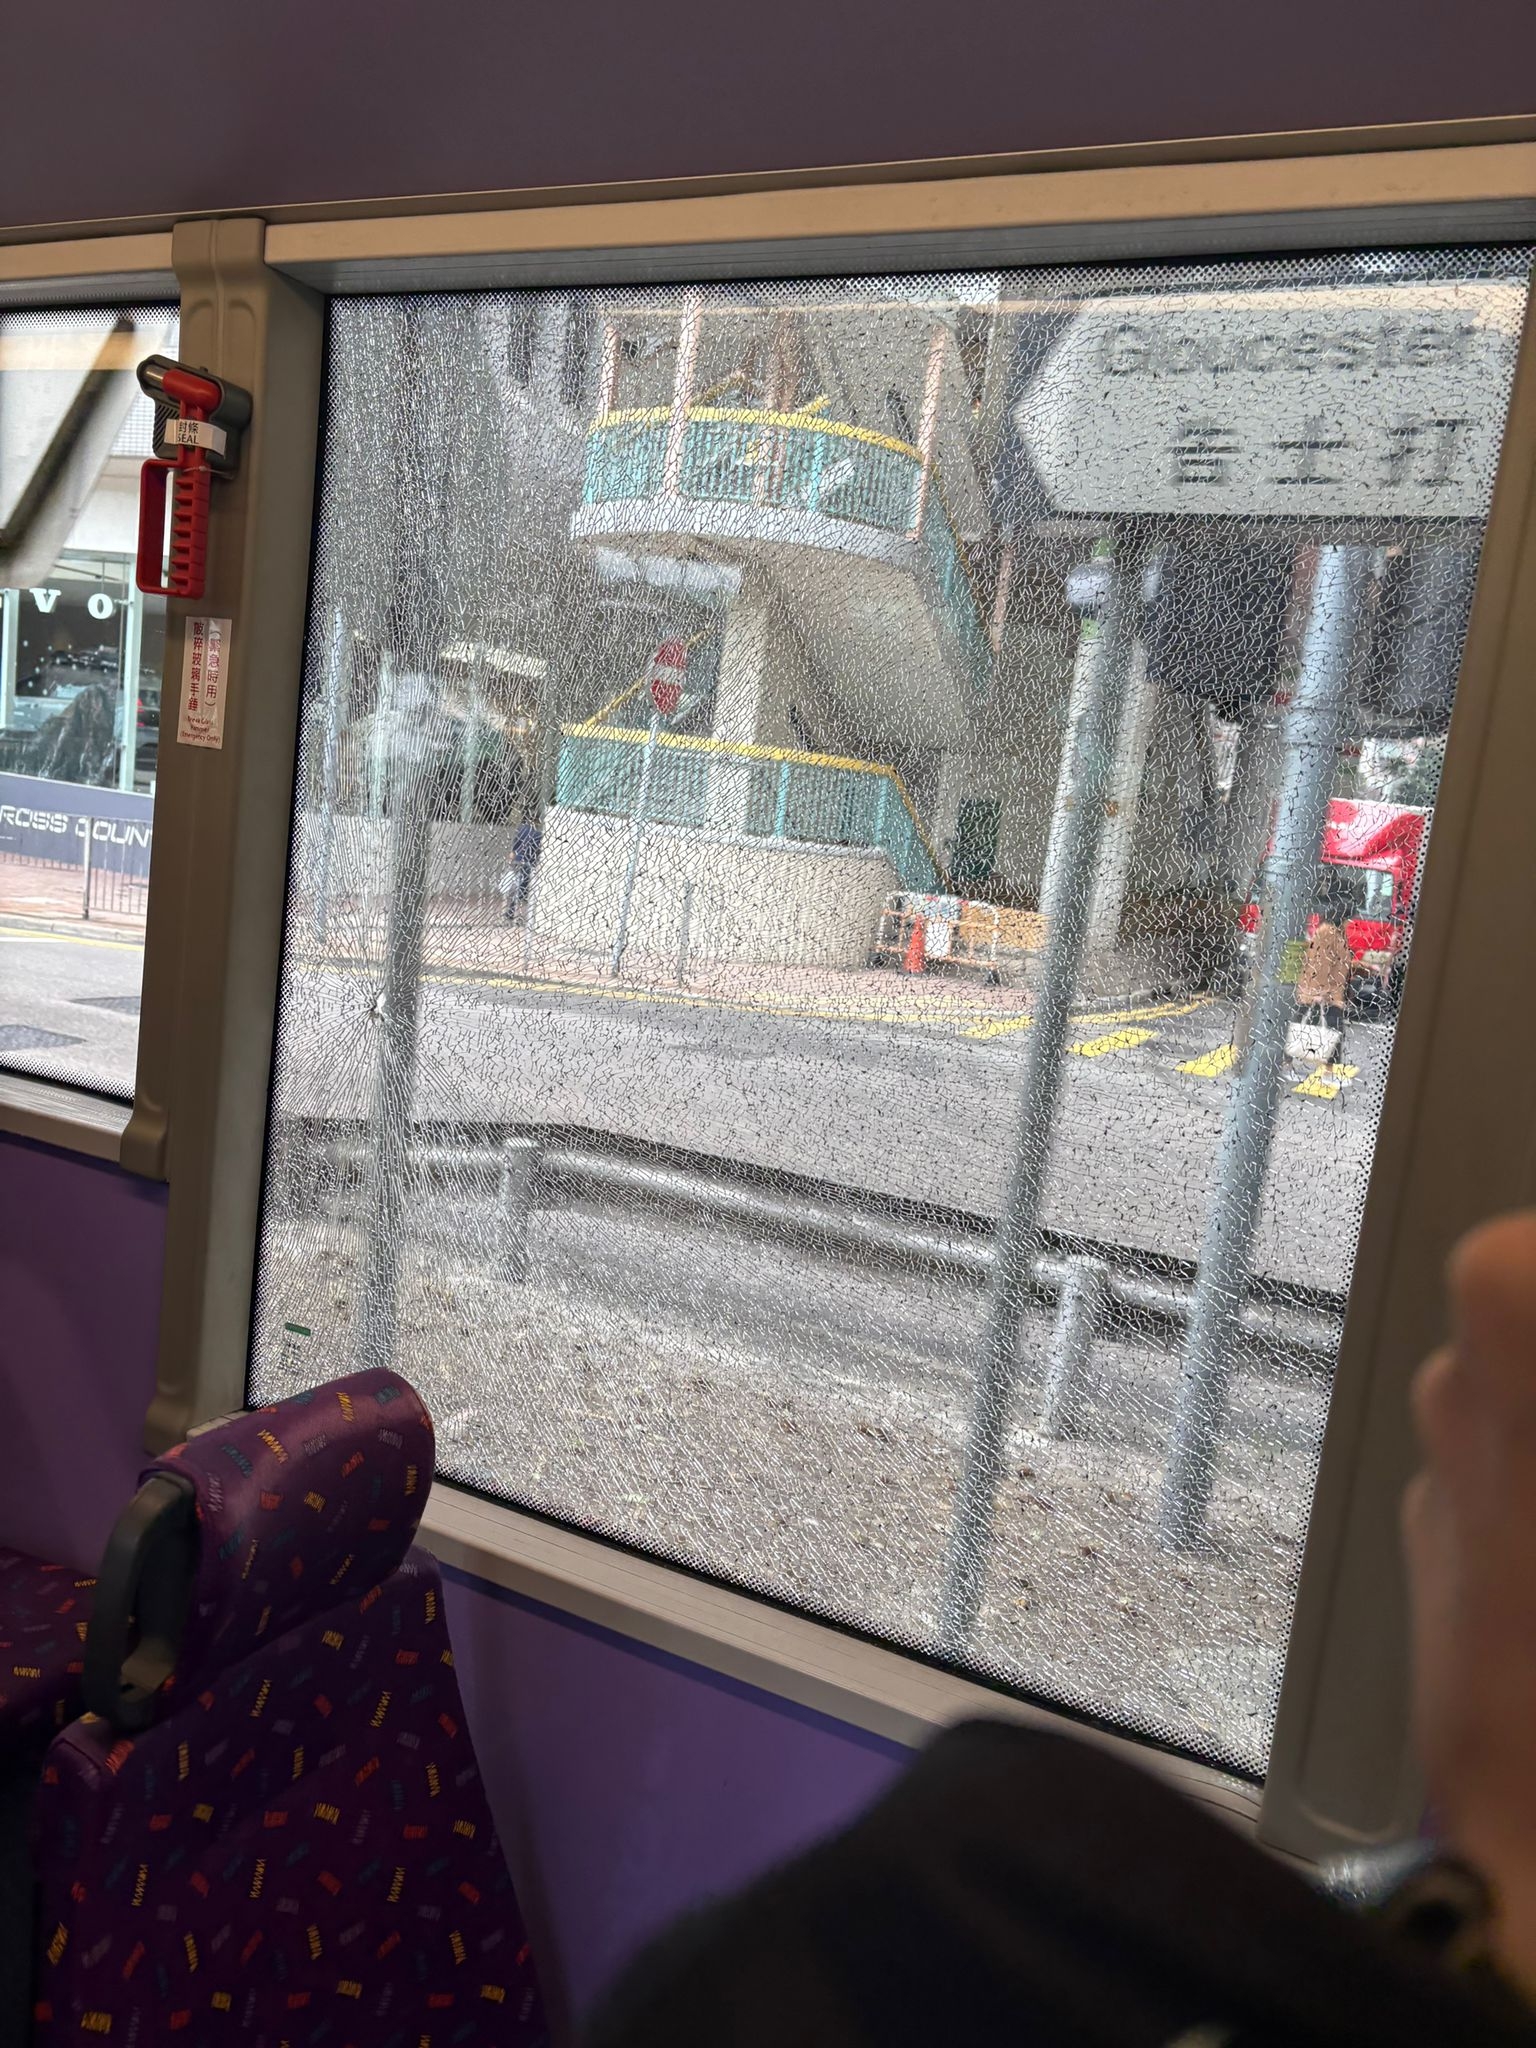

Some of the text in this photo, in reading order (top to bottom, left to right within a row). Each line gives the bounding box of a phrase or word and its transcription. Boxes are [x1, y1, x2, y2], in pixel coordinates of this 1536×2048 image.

[1097, 319, 1475, 376] Gloucester
[177, 433, 199, 445] SEAL
[178, 421, 198, 434] 封條
[1165, 412, 1481, 488] 告士打
[75, 817, 153, 848] COUN
